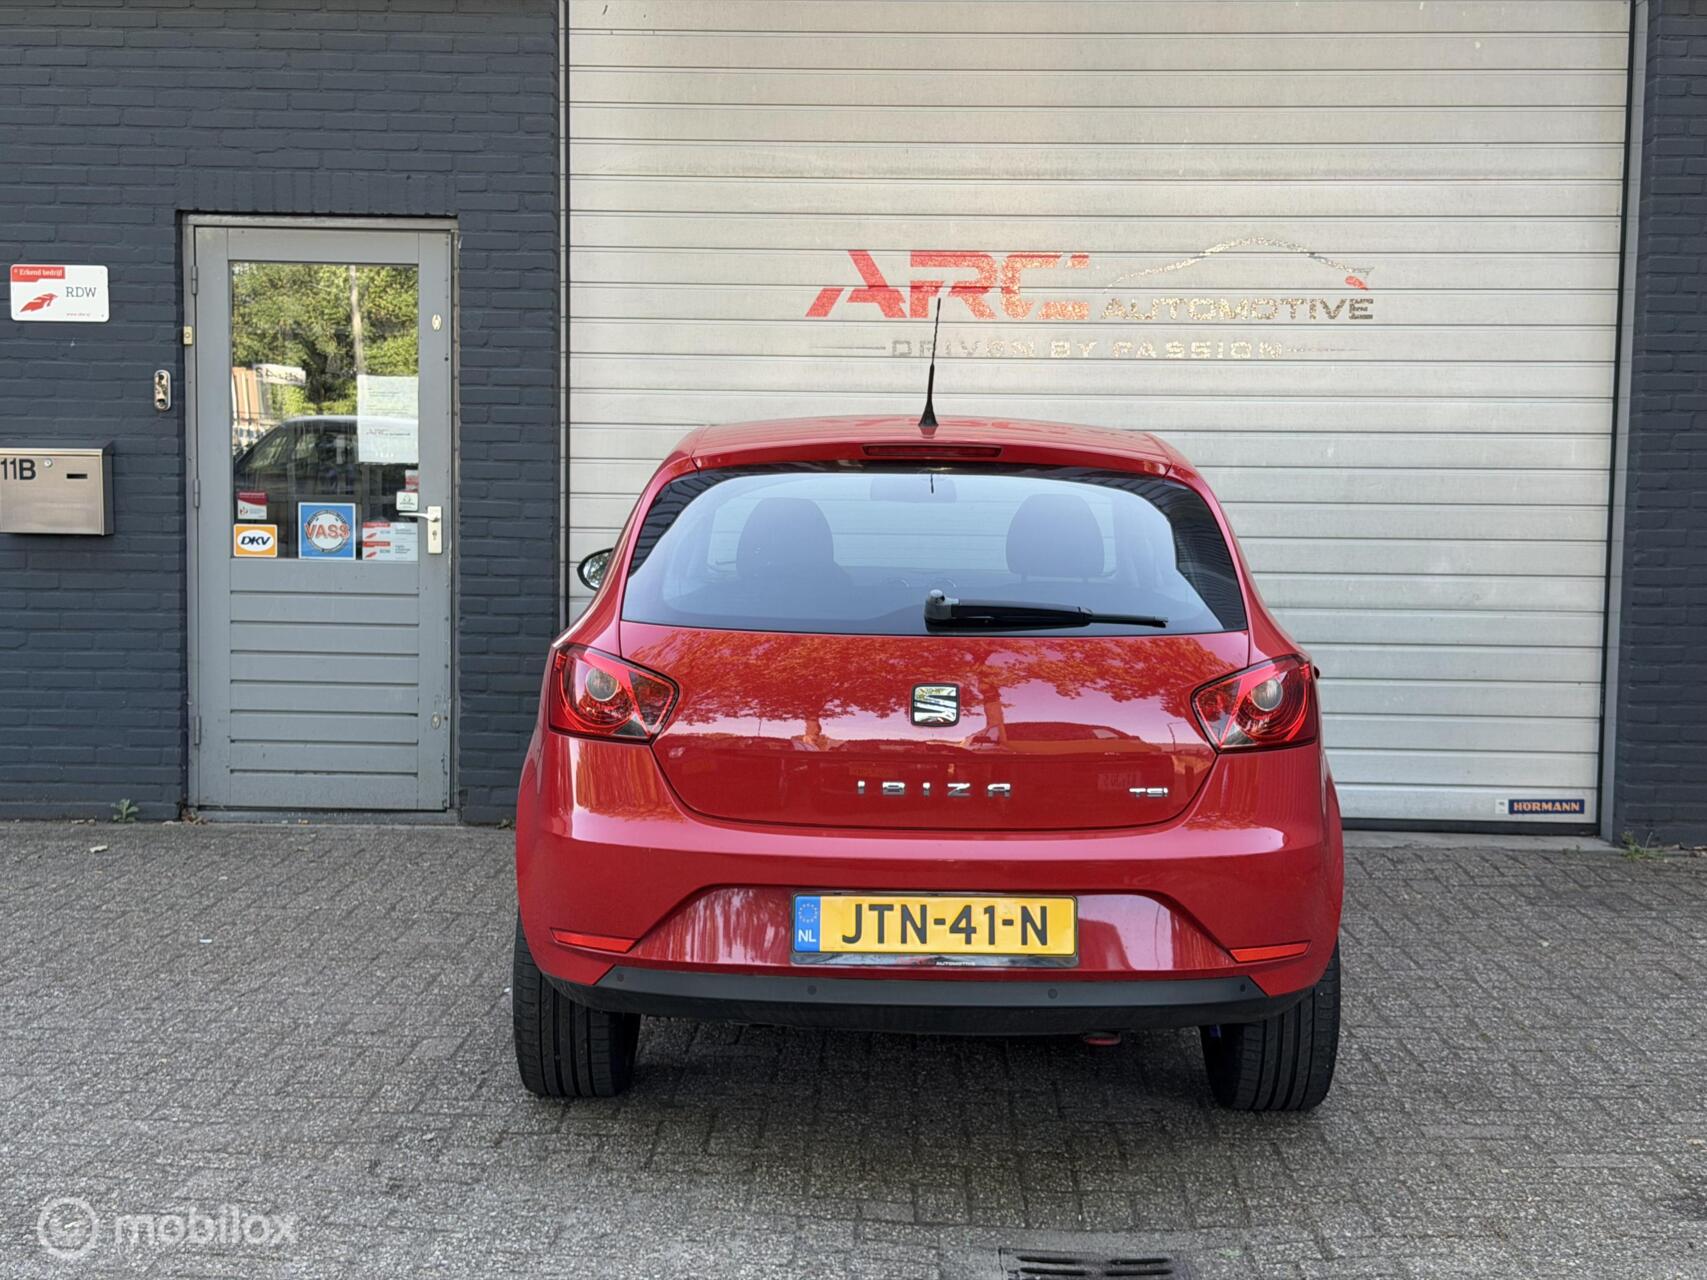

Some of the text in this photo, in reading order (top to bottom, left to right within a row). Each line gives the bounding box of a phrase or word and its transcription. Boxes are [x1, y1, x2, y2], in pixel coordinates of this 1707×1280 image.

[65, 286, 97, 298] RDW
[1101, 298, 1374, 320] AUTOMOTIVE
[892, 340, 1283, 359] DRIVEN BY PASSION
[0, 457, 37, 480] 11B
[240, 535, 271, 546] DKV
[857, 780, 1012, 797] IBIZA
[842, 903, 1048, 946] JTN-41-N
[798, 929, 817, 943] NL
